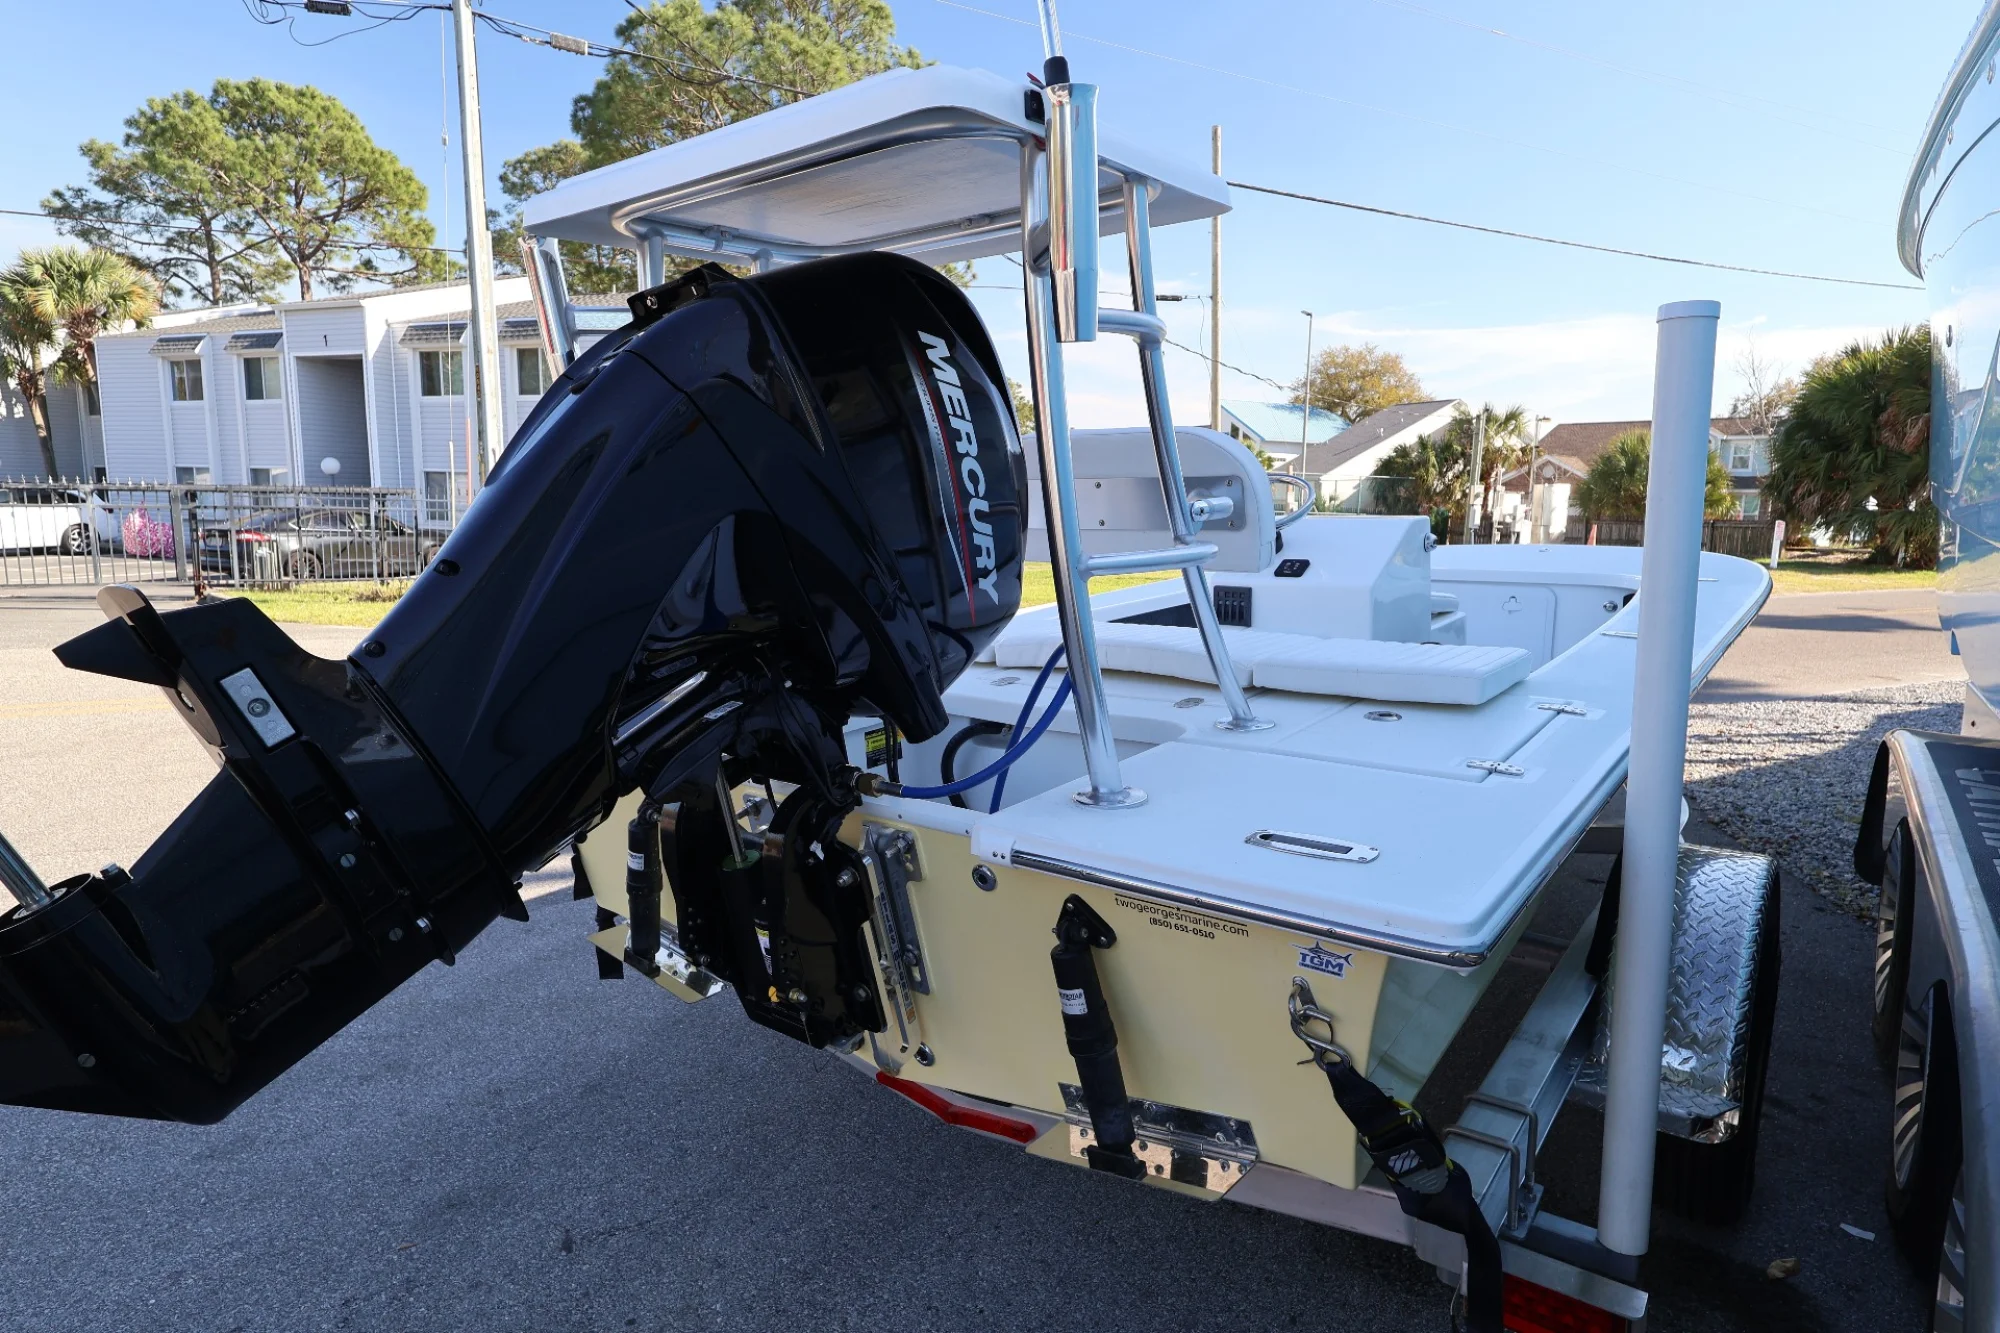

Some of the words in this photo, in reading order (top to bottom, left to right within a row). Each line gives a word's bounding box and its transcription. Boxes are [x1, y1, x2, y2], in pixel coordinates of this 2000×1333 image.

[918, 330, 998, 605] MERCURY
[1115, 898, 1249, 937] twogeorgesmarine.com
[1149, 917, 1172, 930] (850)
[1174, 923, 1215, 940] 651-0510
[1300, 952, 1344, 972] TGM
